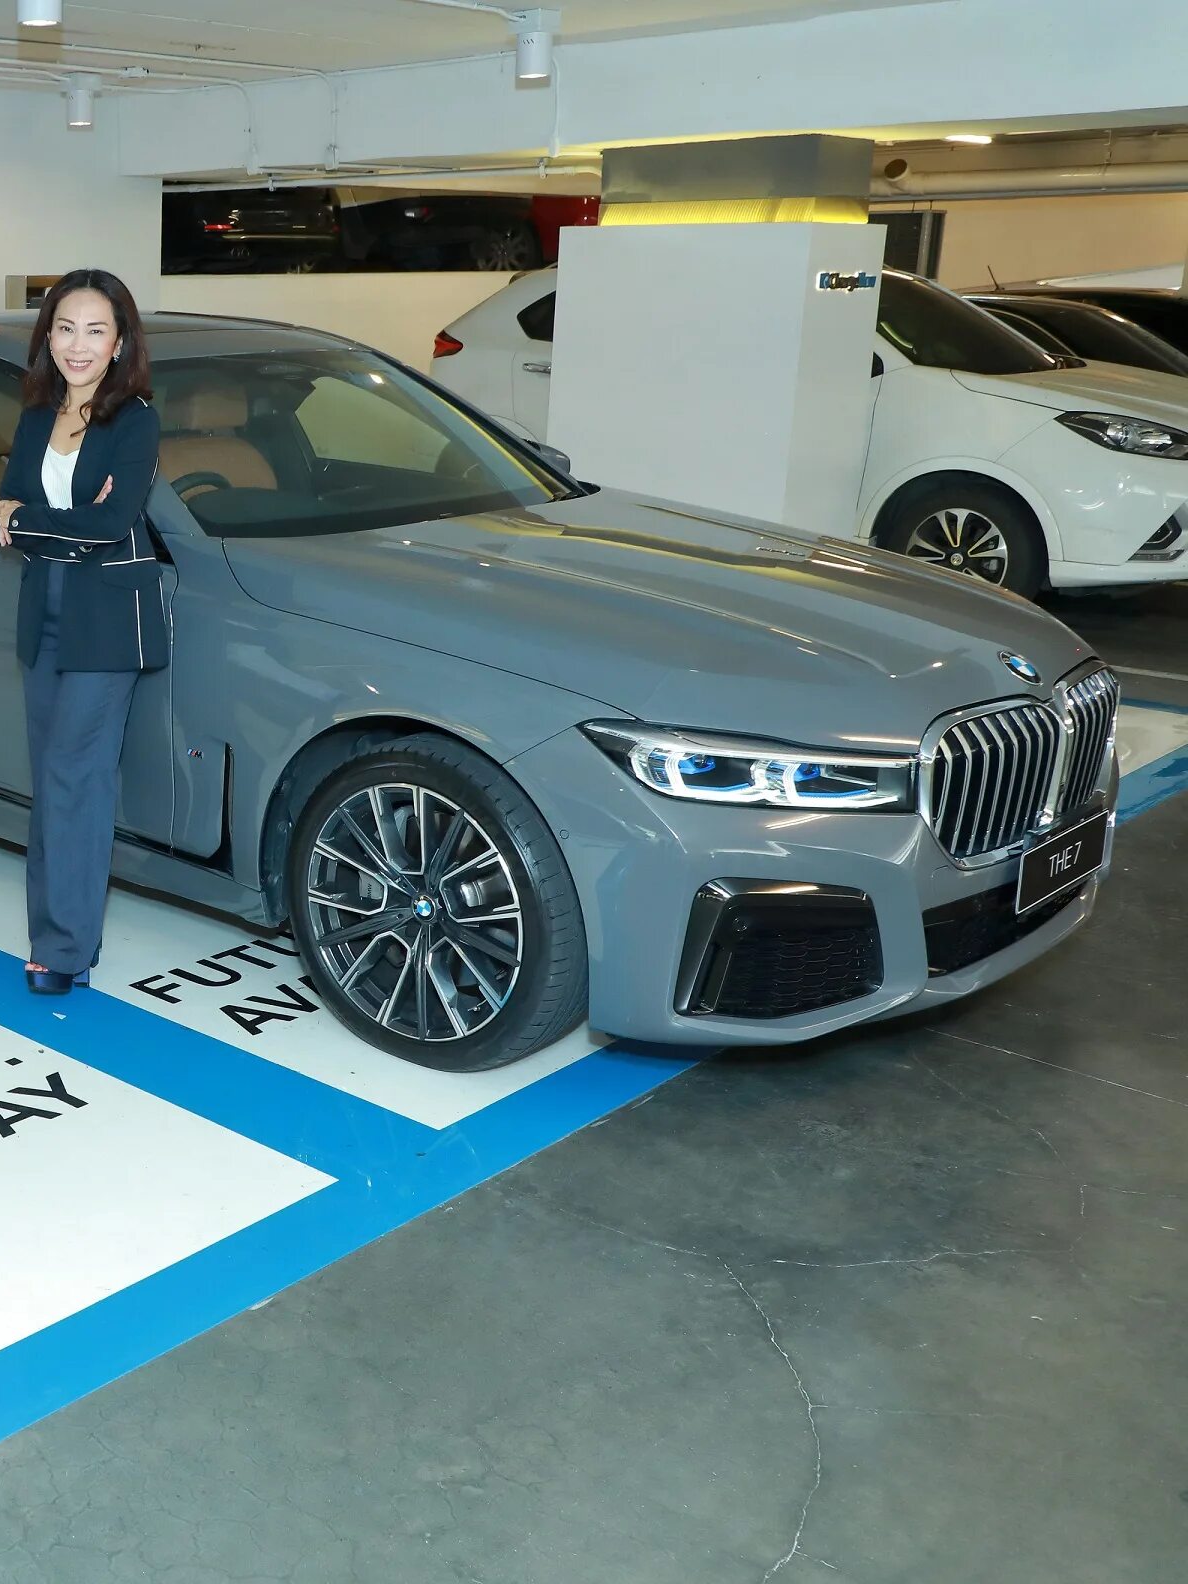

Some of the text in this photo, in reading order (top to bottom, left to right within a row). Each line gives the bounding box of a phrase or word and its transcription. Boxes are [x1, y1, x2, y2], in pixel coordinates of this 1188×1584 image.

[1049, 840, 1082, 878] THE 7
[219, 975, 321, 1036] AV
